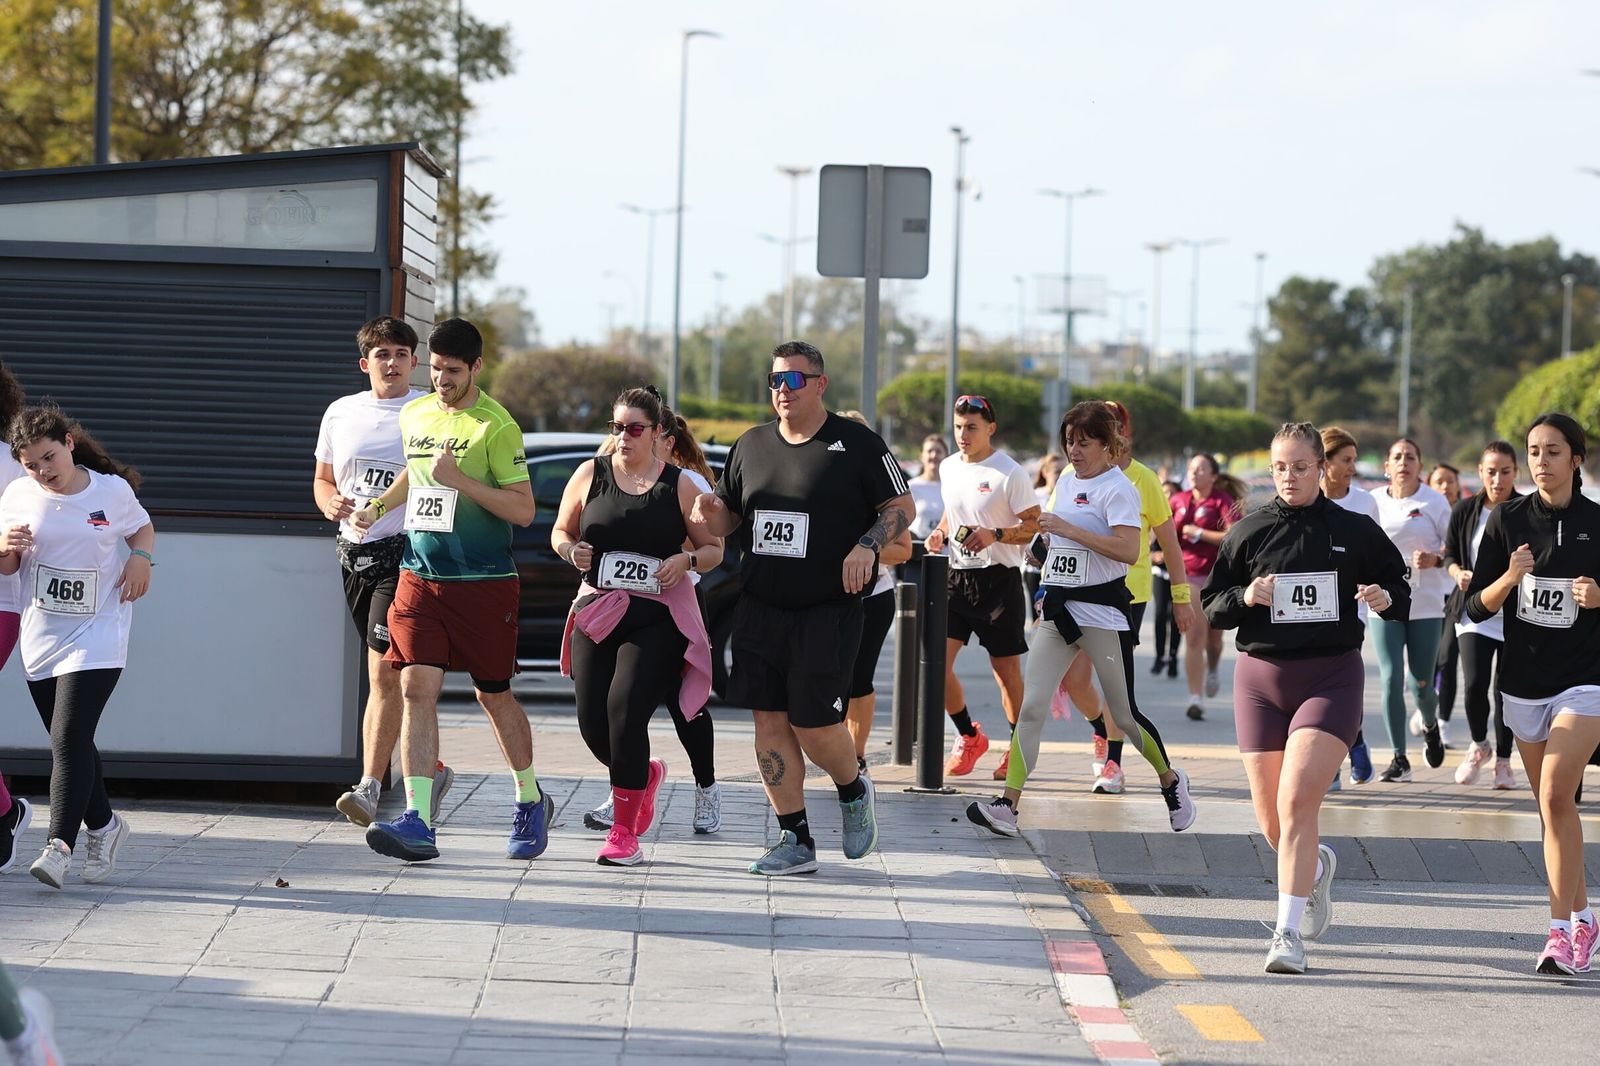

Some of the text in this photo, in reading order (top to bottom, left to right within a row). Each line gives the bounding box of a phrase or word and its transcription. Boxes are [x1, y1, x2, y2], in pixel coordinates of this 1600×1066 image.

[364, 468, 395, 489] 476
[416, 497, 443, 517] 225
[763, 521, 795, 543] 243
[357, 556, 374, 566] NIKE
[613, 560, 649, 581] 226
[1051, 555, 1078, 574] 439
[46, 577, 85, 602] 468
[1291, 584, 1318, 607] 49
[1531, 588, 1564, 612] 142
